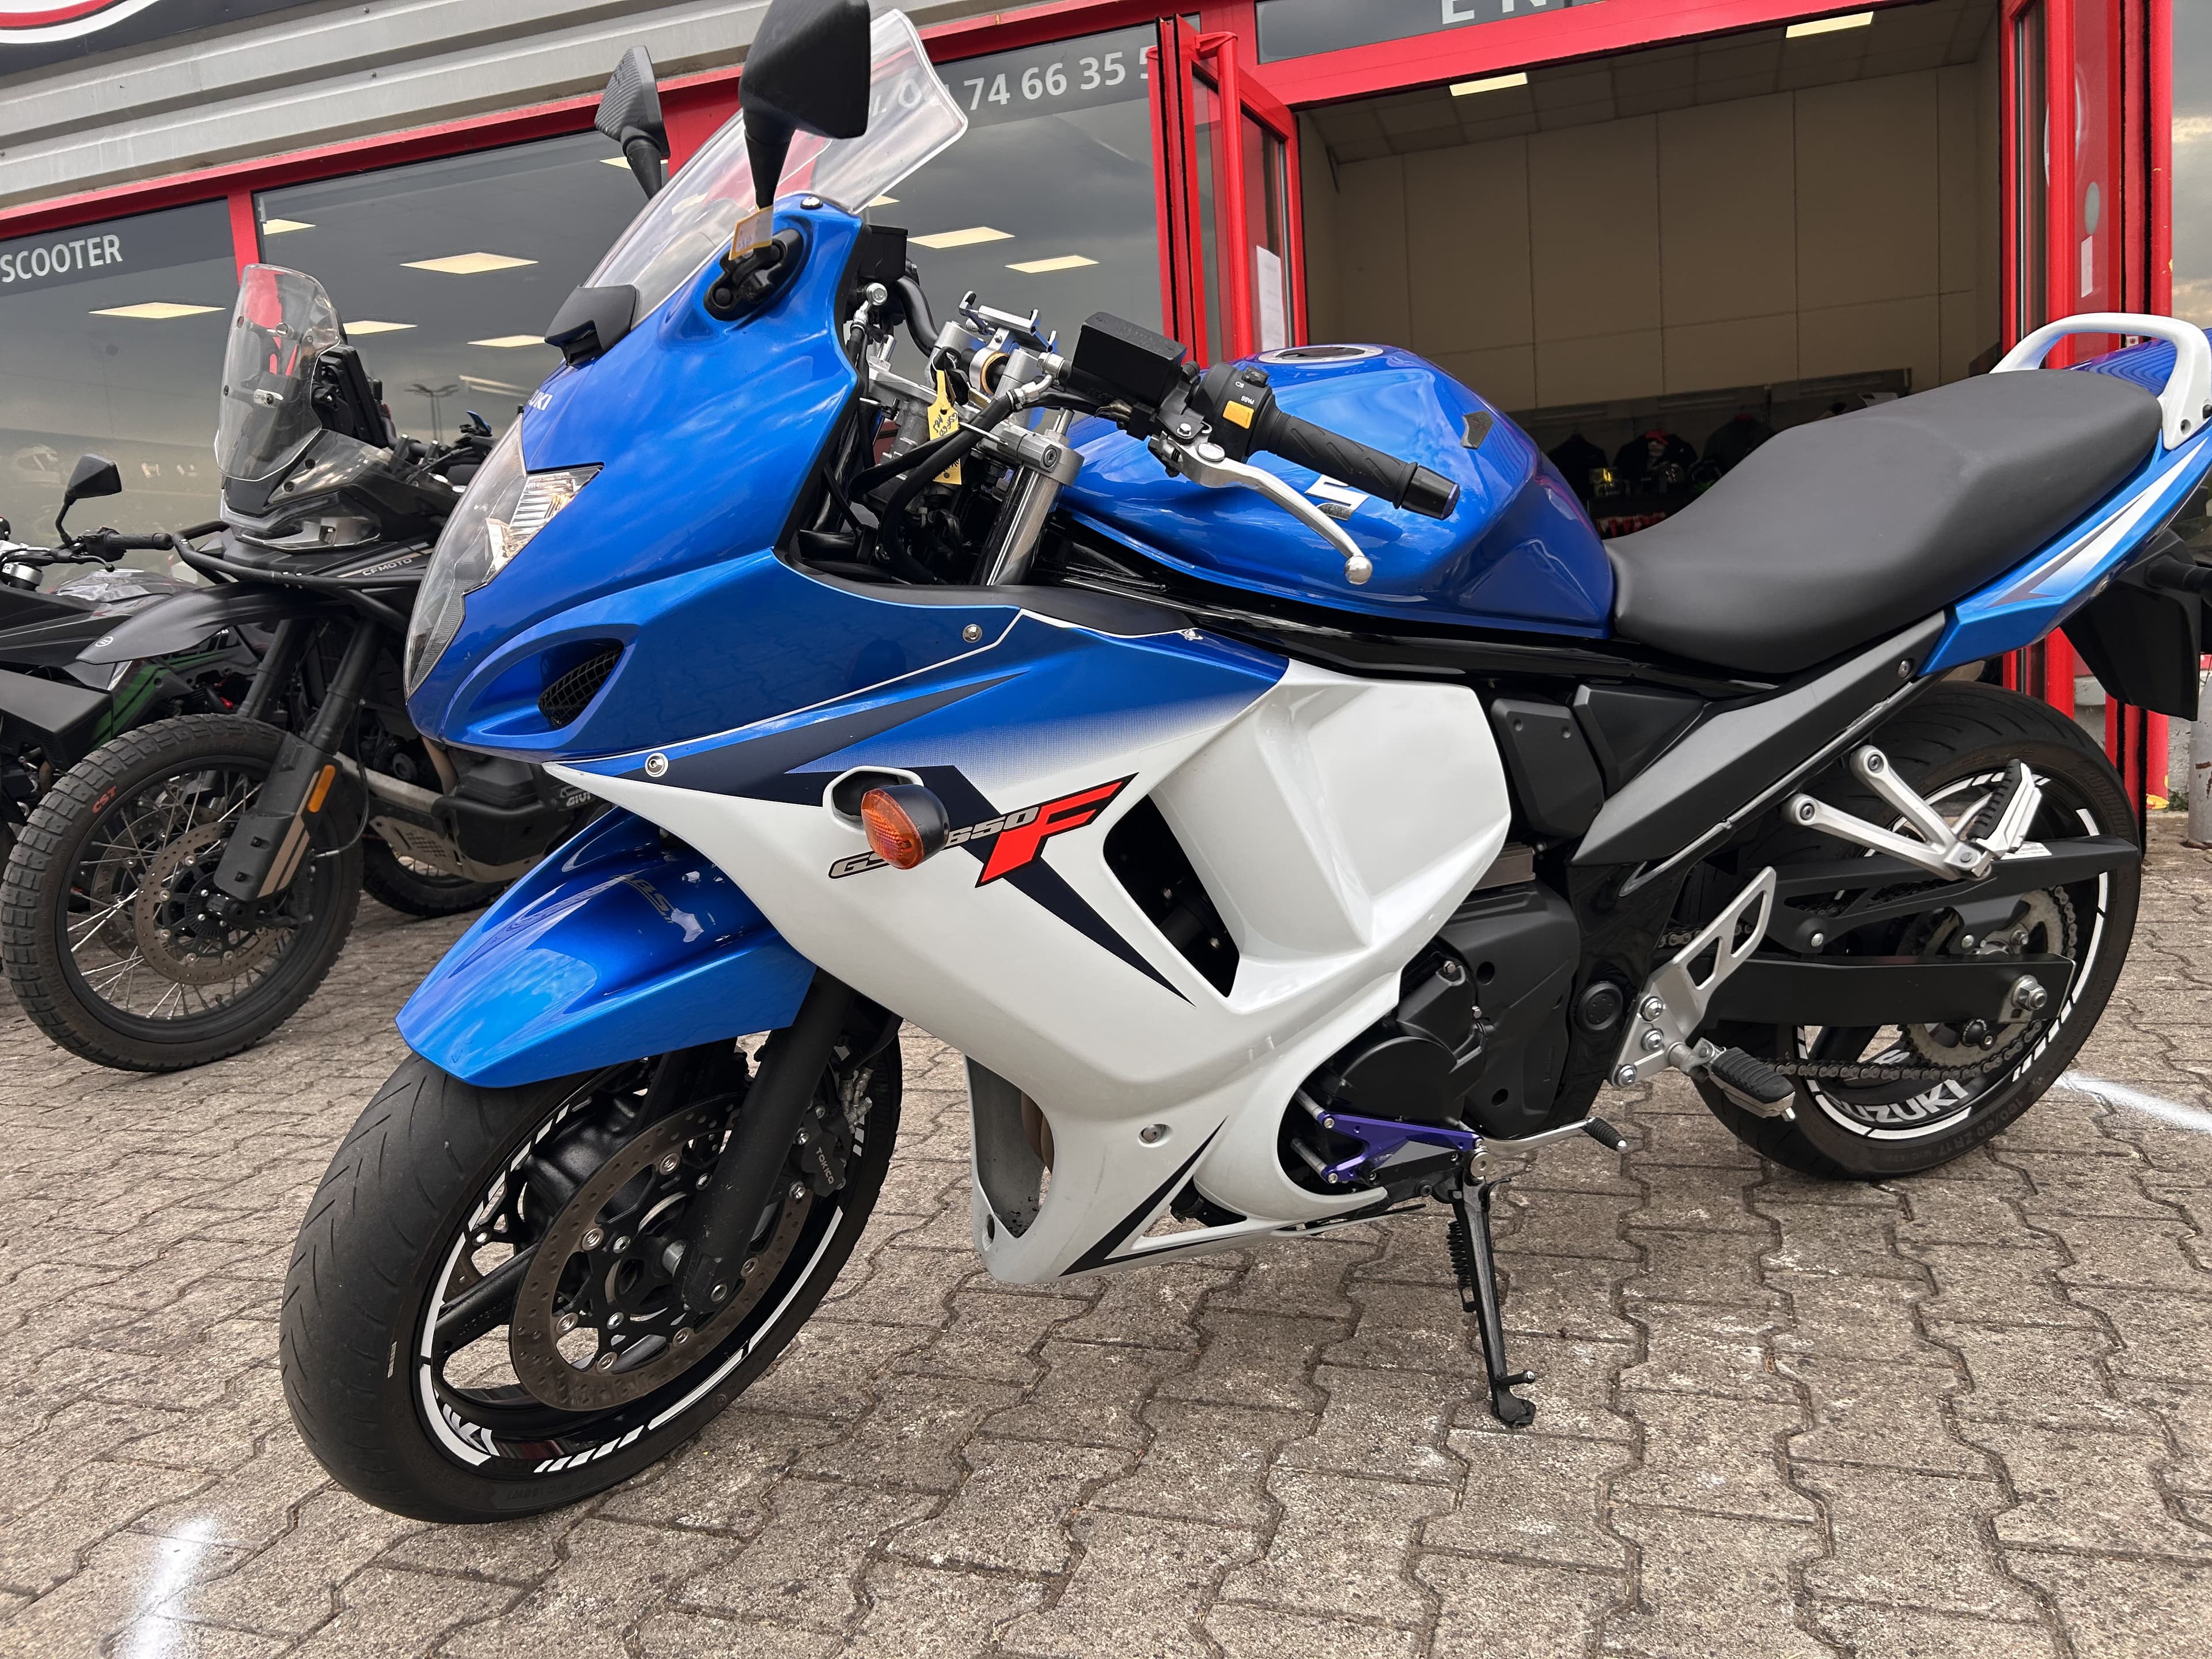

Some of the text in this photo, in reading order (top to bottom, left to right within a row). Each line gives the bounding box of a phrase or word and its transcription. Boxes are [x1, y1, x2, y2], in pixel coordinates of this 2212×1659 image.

[964, 74, 1011, 111] 74
[1021, 63, 1067, 100] 66
[1079, 51, 1126, 90] 35
[0, 234, 123, 283] SCOOTER
[362, 558, 412, 576] CFMOTO
[93, 785, 116, 813] CST
[816, 1147, 834, 1184] TOKICO
